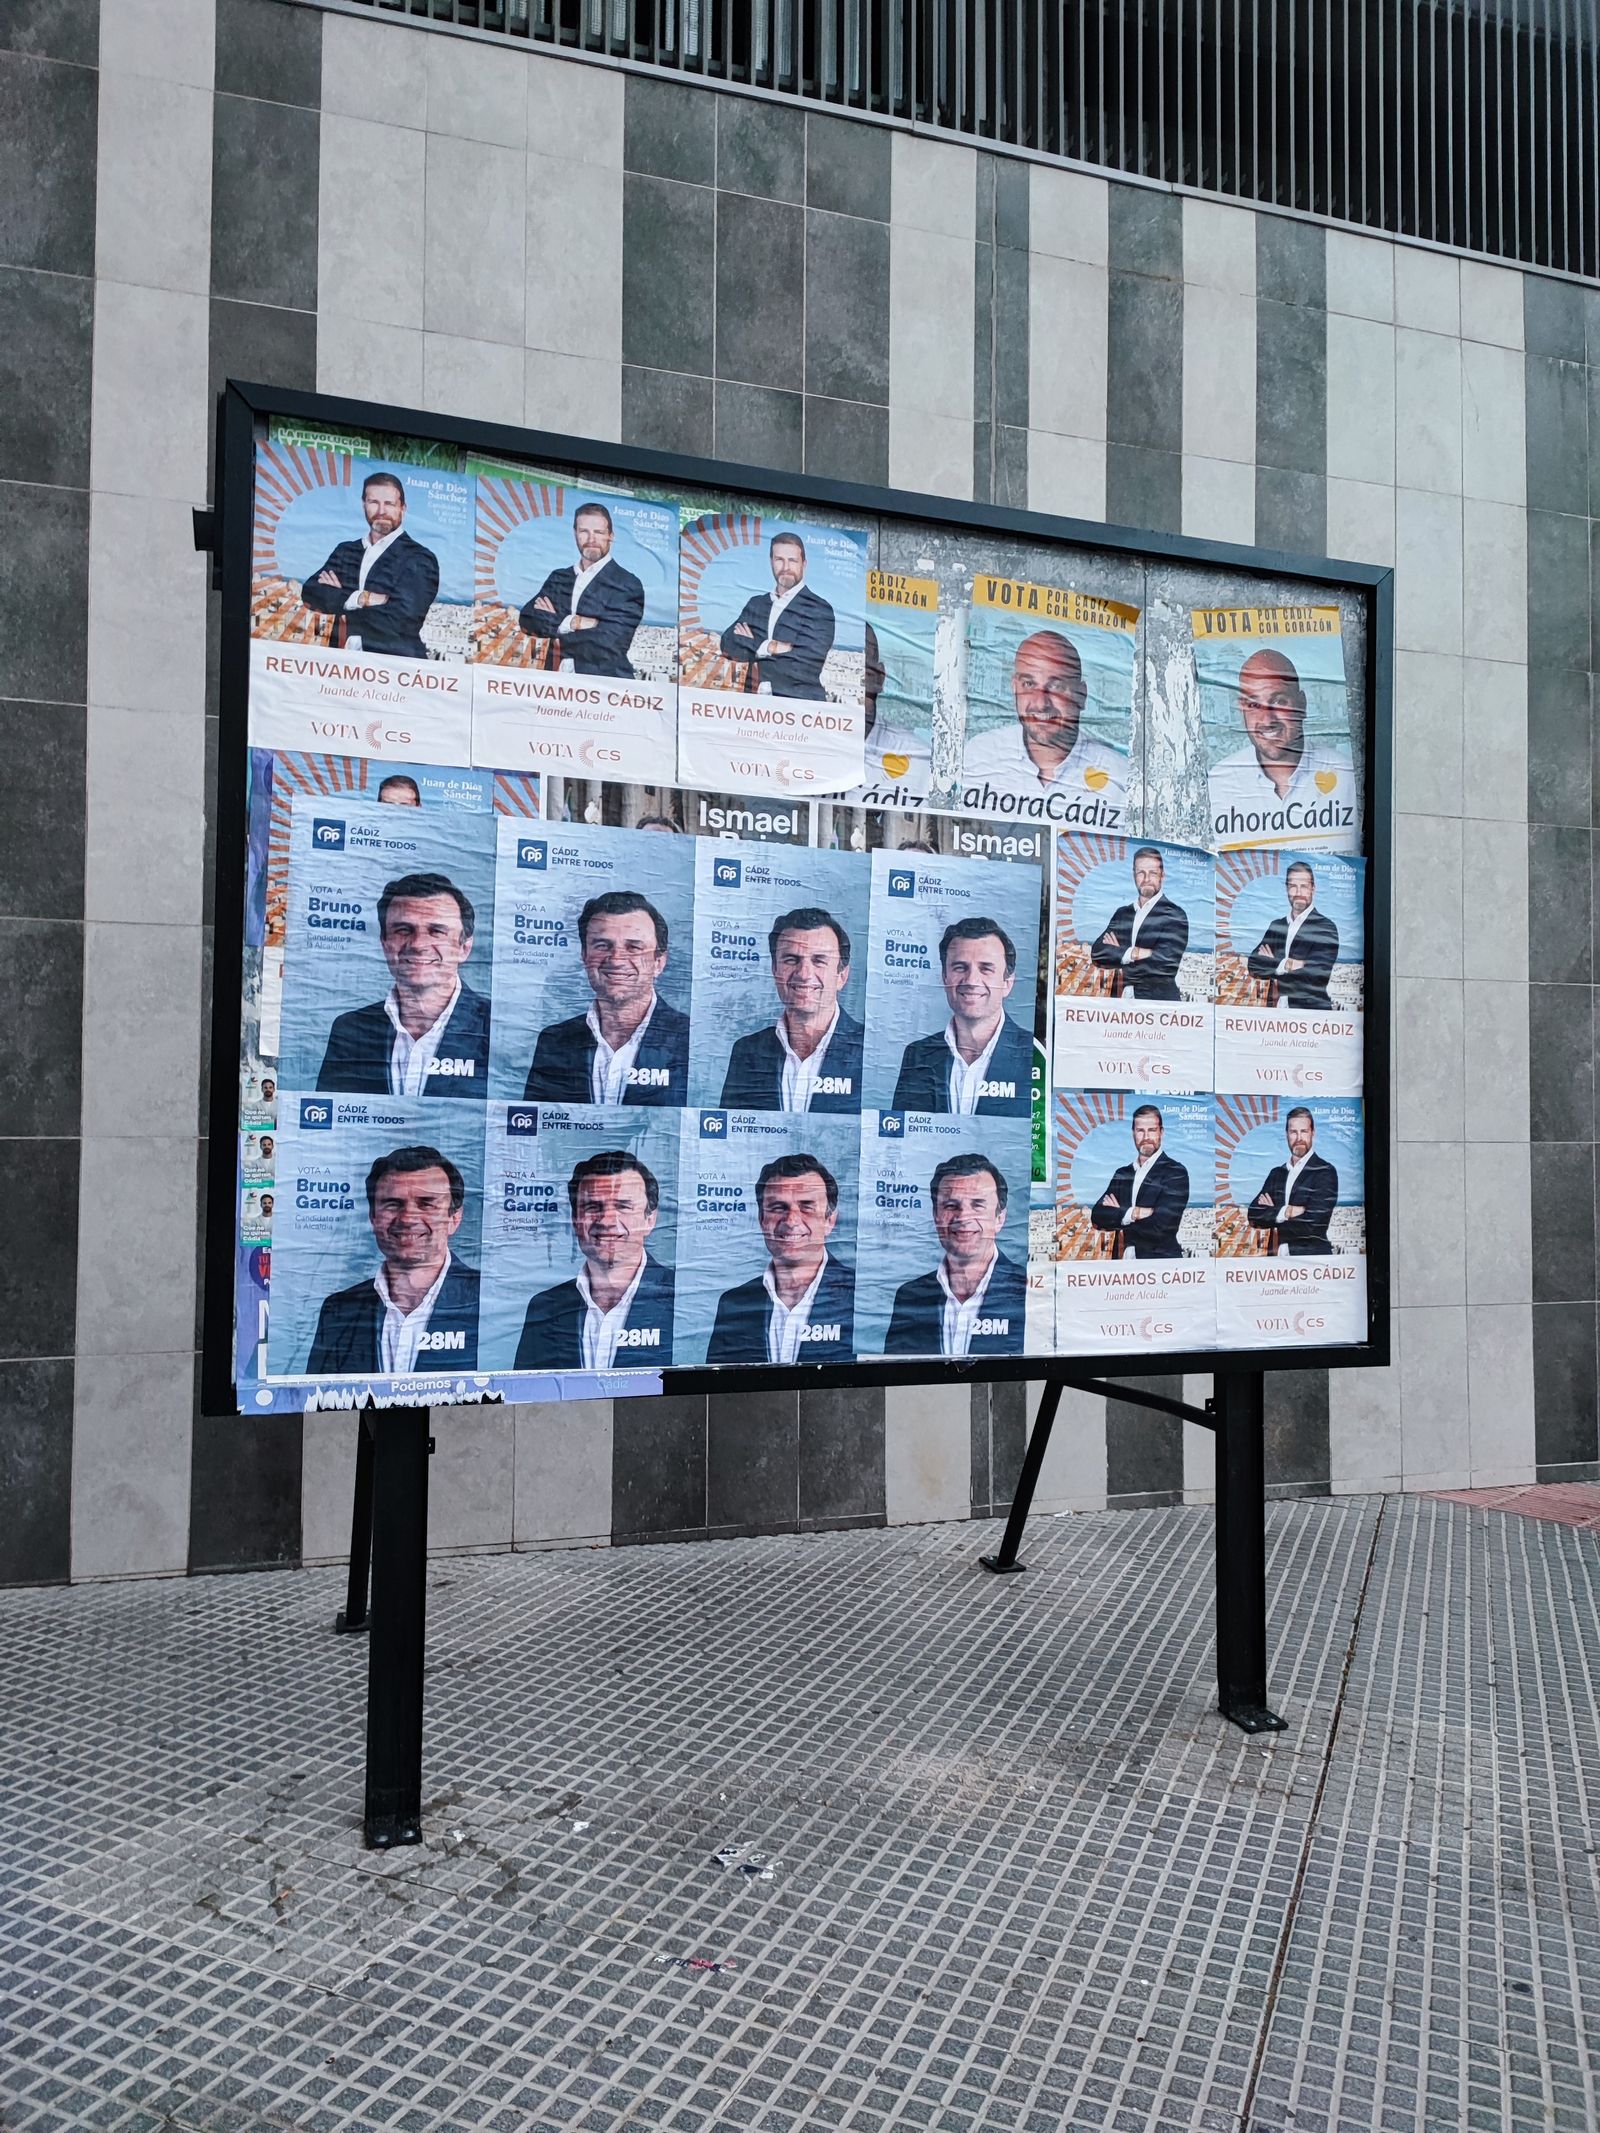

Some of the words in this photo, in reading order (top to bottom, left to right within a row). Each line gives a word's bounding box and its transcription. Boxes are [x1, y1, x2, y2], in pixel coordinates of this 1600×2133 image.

[406, 477, 430, 489] Juan
[432, 479, 443, 490] de
[447, 482, 468, 494] Dios
[428, 489, 467, 504] Sánchez
[613, 505, 635, 517] Juan
[637, 507, 648, 518] de
[870, 586, 927, 607] CORAZÓN
[987, 580, 1039, 610] VOTA
[1047, 589, 1069, 605] POR
[1046, 603, 1068, 618] CON
[1075, 608, 1127, 629] CORAZÓN
[1257, 608, 1277, 620] POR
[1203, 611, 1252, 634] VOTA
[1259, 622, 1279, 634] CON
[1285, 618, 1332, 633] CORAZÓN
[266, 656, 390, 685] REVIVAMOS
[397, 669, 459, 692] CÁDIZ
[317, 684, 359, 698] Juande
[362, 689, 406, 703] Alcalde
[488, 680, 601, 704] REVIVAMOS
[607, 690, 664, 711] CÁDIZ
[536, 705, 573, 718] Juande
[575, 709, 616, 722] Alcalde
[691, 702, 795, 726] REVIVAMOS
[801, 712, 853, 732] CÁDIZ
[311, 721, 359, 740] VOTA
[736, 727, 770, 739] Juande
[772, 730, 809, 743] Alcalde
[528, 741, 573, 759] VOTA
[730, 761, 771, 778] VOTA
[421, 777, 445, 788] Juan
[448, 779, 459, 789] de
[963, 782, 1121, 829] ahoraCádiz
[700, 800, 798, 835] Ismael
[1215, 800, 1354, 834] ahoraCádiz
[350, 826, 380, 837] CÁDIZ
[350, 837, 381, 848] ENTRE
[385, 840, 417, 850] TODOS
[952, 825, 1041, 858] Ismael
[552, 847, 579, 857] CÁDIZ
[551, 857, 581, 867] ENTRE
[583, 860, 614, 869] TODOS
[745, 865, 770, 875] CÁDIZ
[745, 876, 772, 885] ENTRE
[774, 878, 801, 887] TODOS
[918, 875, 942, 886] CÁDIZ
[310, 884, 333, 895] VOTA
[918, 886, 943, 895] ENTRE
[945, 888, 971, 898] TODOS
[308, 897, 362, 915] Bruno
[515, 903, 537, 912] VOTA
[307, 914, 366, 931] García
[514, 915, 564, 931] Bruno
[513, 930, 568, 947] García
[711, 931, 756, 947] Bruno
[887, 929, 905, 937] VOTA
[711, 946, 760, 962] García
[885, 939, 928, 955] Bruno
[884, 954, 931, 970] García
[1066, 1009, 1154, 1025] REVIVAMOS
[1160, 1011, 1204, 1028] CÁDIZ
[1225, 1018, 1307, 1034] REVIVAMOS
[1312, 1019, 1354, 1036] CÁDIZ
[1102, 1029, 1133, 1039] Juande
[1135, 1031, 1166, 1041] Alcalde
[426, 1057, 475, 1077] 28M
[1098, 1061, 1133, 1074] VOTA
[625, 1067, 669, 1086] 28M
[1256, 1069, 1288, 1081] VOTA
[811, 1076, 851, 1095] 28M
[978, 1081, 1016, 1098] 28M
[338, 1103, 367, 1113] CÁDIZ
[542, 1111, 569, 1120] CÁDIZ
[337, 1115, 369, 1124] ENTRE
[372, 1116, 405, 1125] TODOS
[542, 1122, 572, 1130] ENTRE
[575, 1122, 604, 1131] TODOS
[731, 1114, 757, 1124] CÁDIZ
[908, 1115, 932, 1124] CÁDIZ
[731, 1125, 758, 1133] ENTRE
[761, 1126, 788, 1134] TODOS
[908, 1125, 933, 1133] ENTRE
[935, 1126, 961, 1134] TODOS
[297, 1166, 321, 1174] VOTA
[698, 1173, 718, 1181] VOTA
[296, 1178, 350, 1193] Bruno
[504, 1183, 554, 1196] Bruno
[697, 1184, 743, 1197] Bruno
[876, 1180, 918, 1194] Bruno
[295, 1194, 354, 1210] García
[503, 1199, 558, 1213] García
[696, 1199, 746, 1212] García
[875, 1195, 921, 1209] García
[1067, 1272, 1156, 1287] REVIVAMOS
[1161, 1268, 1206, 1285] CÁDIZ
[1225, 1268, 1308, 1283] REVIVAMOS
[1313, 1265, 1356, 1281] CÁDIZ
[1104, 1291, 1135, 1301] Juande
[1136, 1290, 1168, 1300] Alcalde
[1260, 1287, 1289, 1296] Juande
[1290, 1286, 1319, 1295] Alcalde
[970, 1318, 1009, 1335] 28M
[1100, 1323, 1136, 1336] VOTA
[1256, 1318, 1289, 1330] VOTA
[416, 1331, 465, 1350] 28M
[615, 1328, 660, 1347] 28M
[800, 1324, 841, 1342] 28M
[391, 1378, 451, 1392] Podemos
[597, 1378, 629, 1389] Cádiz
